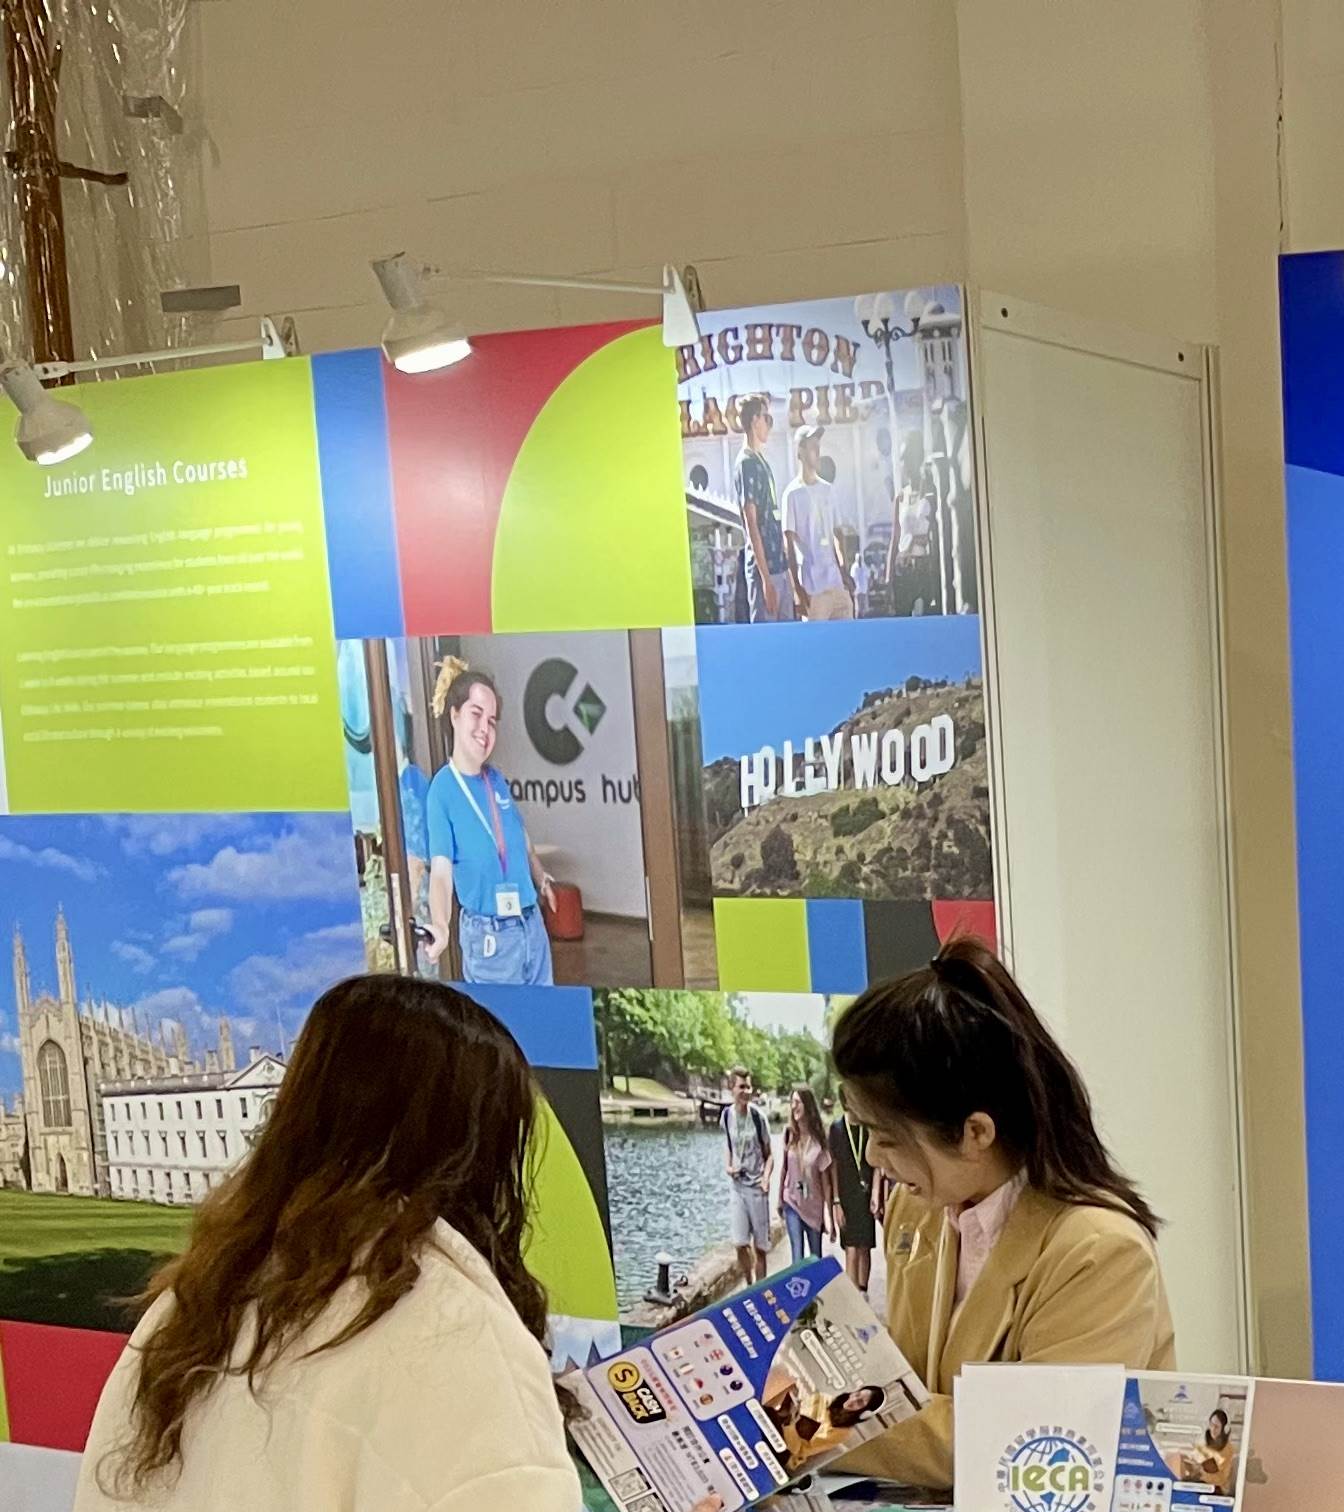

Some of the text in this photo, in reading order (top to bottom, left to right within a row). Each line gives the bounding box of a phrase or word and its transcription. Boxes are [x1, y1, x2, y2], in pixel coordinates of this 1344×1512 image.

[44, 457, 248, 498] Junior English Courses
[740, 713, 956, 812] HOLLYWOOD
[505, 778, 586, 808] ampus
